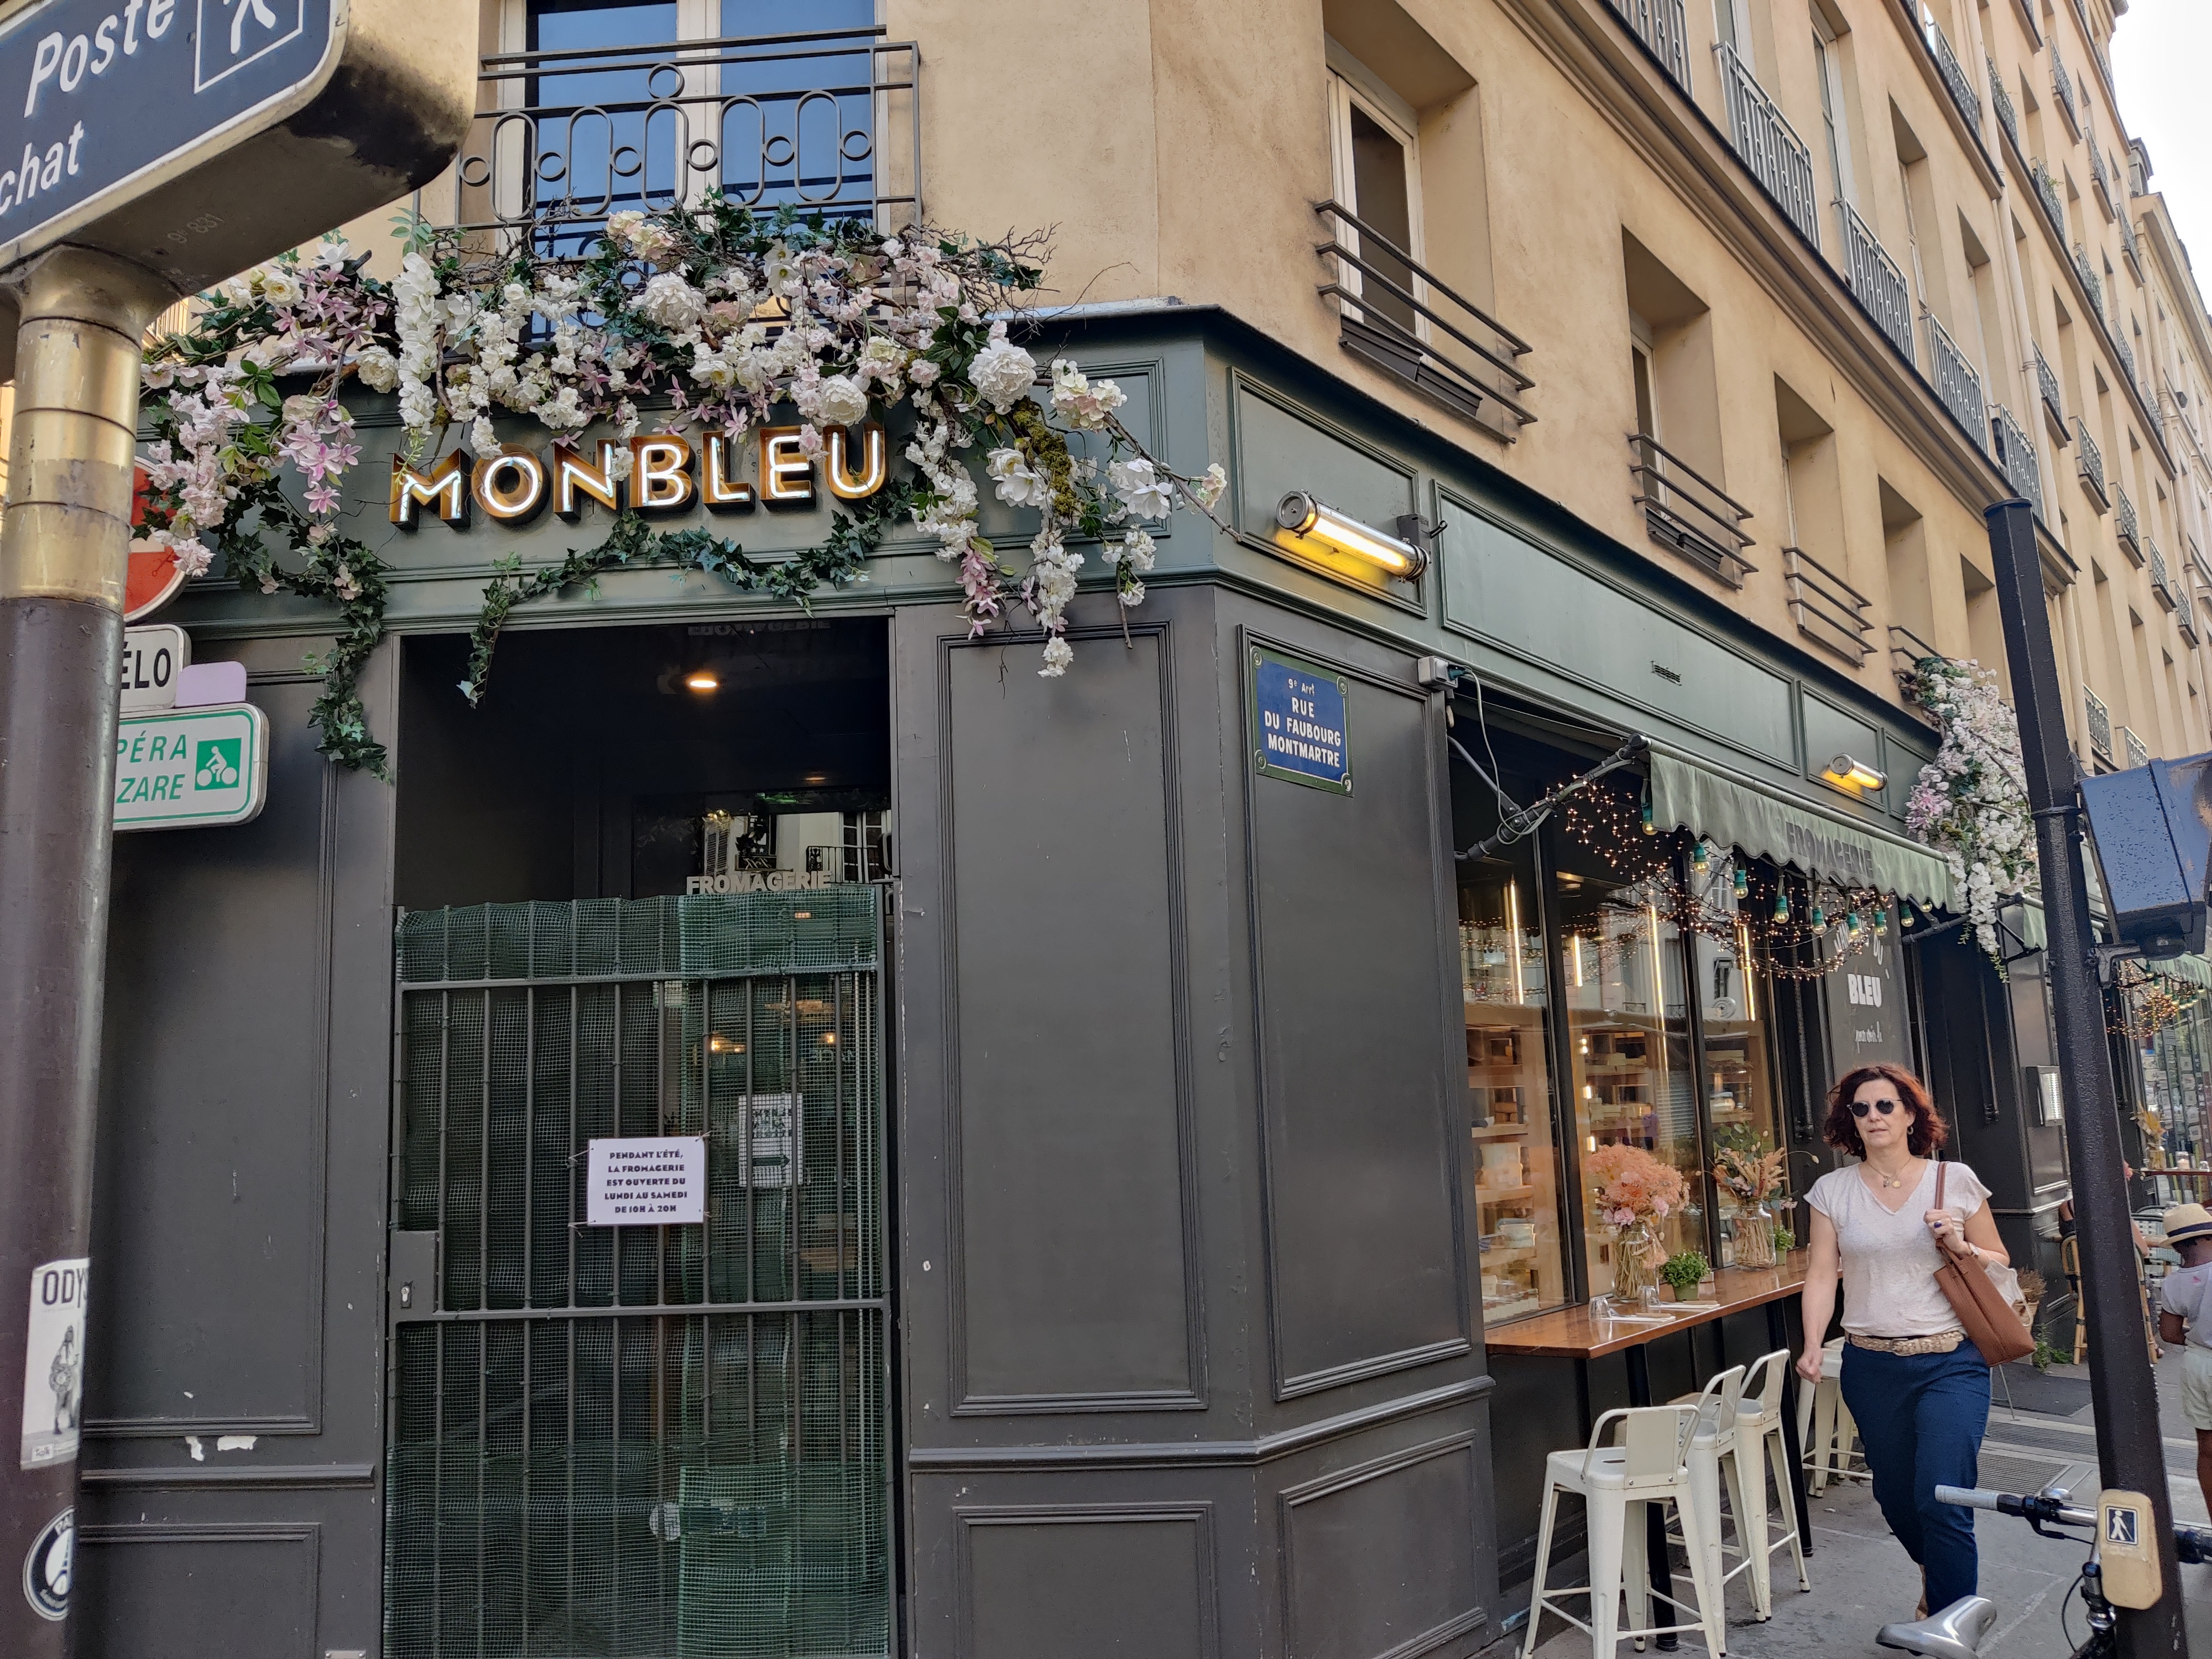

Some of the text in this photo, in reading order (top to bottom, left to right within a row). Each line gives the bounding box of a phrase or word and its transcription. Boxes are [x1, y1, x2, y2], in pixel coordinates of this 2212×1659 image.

[24, 0, 175, 118] Poste
[388, 422, 886, 530] MONBLEU
[1291, 696, 1314, 718] RUE
[1264, 710, 1341, 747] DU FAUBOURG
[1267, 733, 1340, 768] MONTMARTRE
[116, 774, 186, 804] ZARE
[686, 870, 832, 895] FROMAGERIE
[1847, 973, 1882, 1007] BLEU
[622, 1164, 685, 1172] FROMAGERIE
[648, 1203, 655, 1212] À
[43, 1268, 88, 1308] ODY
